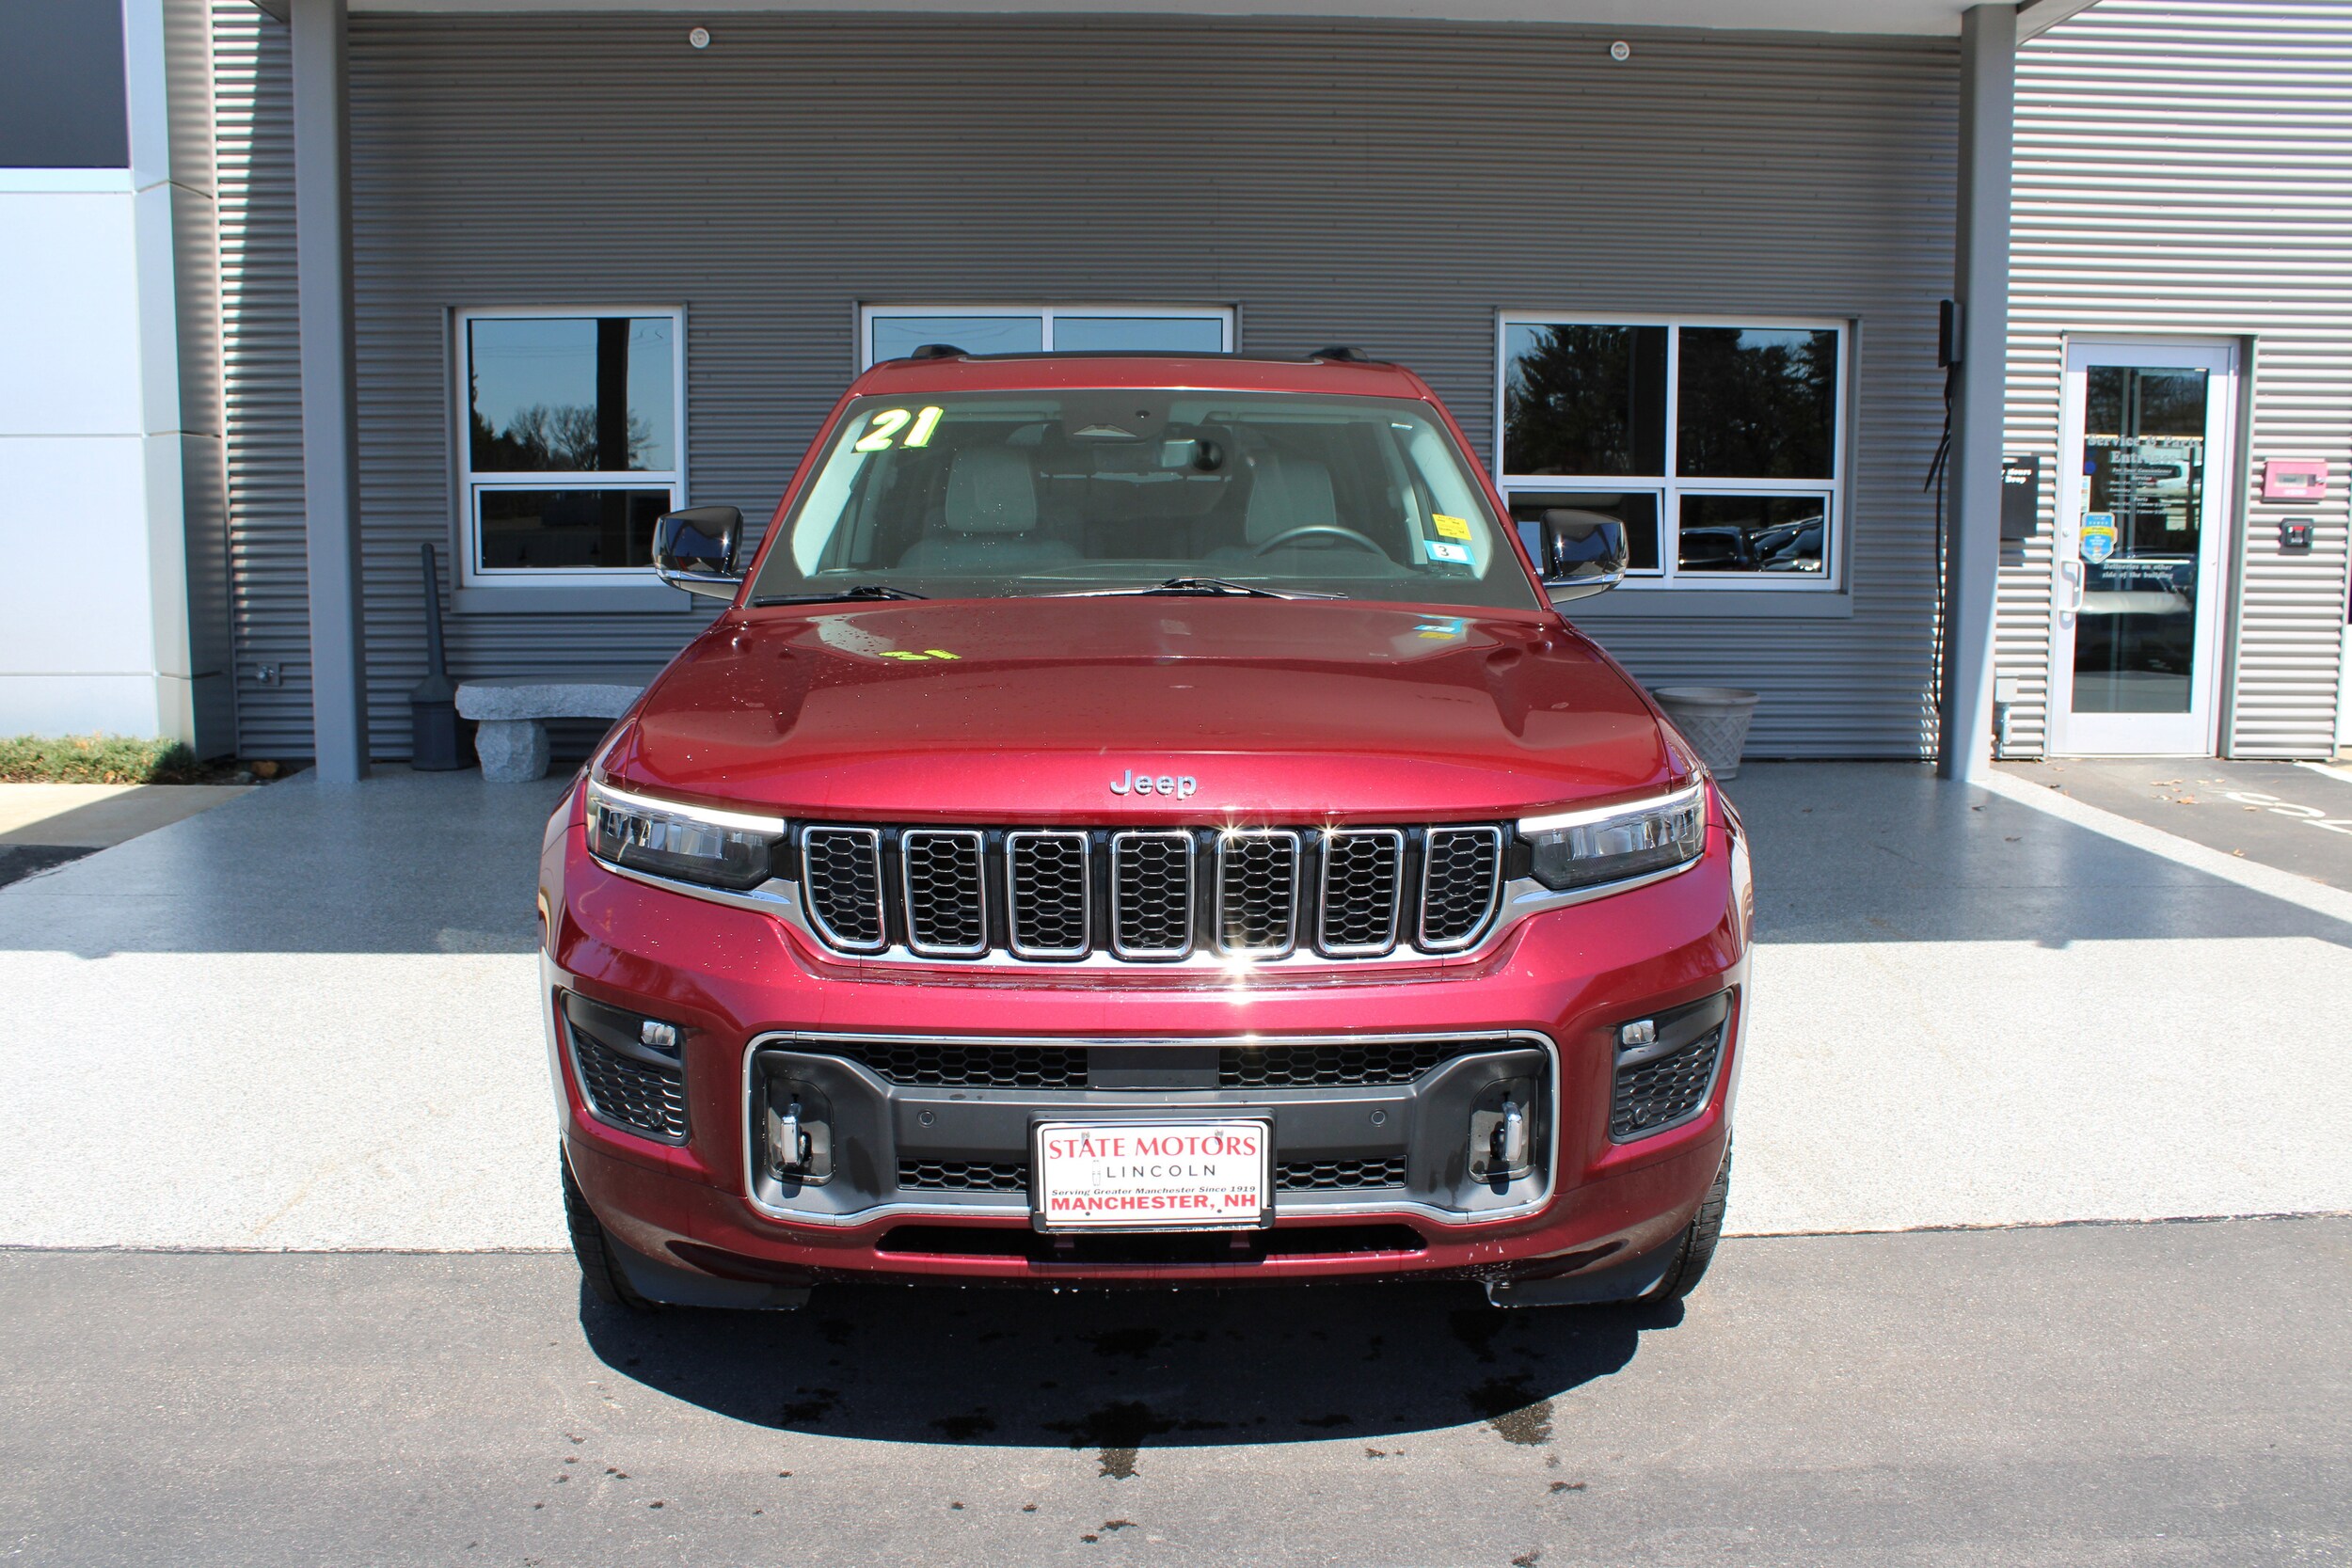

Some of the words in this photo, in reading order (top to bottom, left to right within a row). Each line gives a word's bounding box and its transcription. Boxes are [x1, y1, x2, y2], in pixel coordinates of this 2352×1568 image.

[854, 405, 944, 452] 21
[2088, 434, 2139, 447] Service
[2146, 435, 2157, 447] &
[2164, 436, 2201, 448] Parts
[2110, 451, 2176, 464] Entrance
[2007, 467, 2032, 476] Hours
[2005, 475, 2027, 484] Drop
[1438, 546, 1450, 557] 3
[1110, 769, 1197, 800] Jeep
[1049, 1137, 1125, 1159] STATE
[1135, 1135, 1257, 1157] MOTORS
[1106, 1164, 1216, 1179] LINCOLN
[1051, 1195, 1215, 1211] MANCHESTER,
[1224, 1194, 1256, 1207] NH
